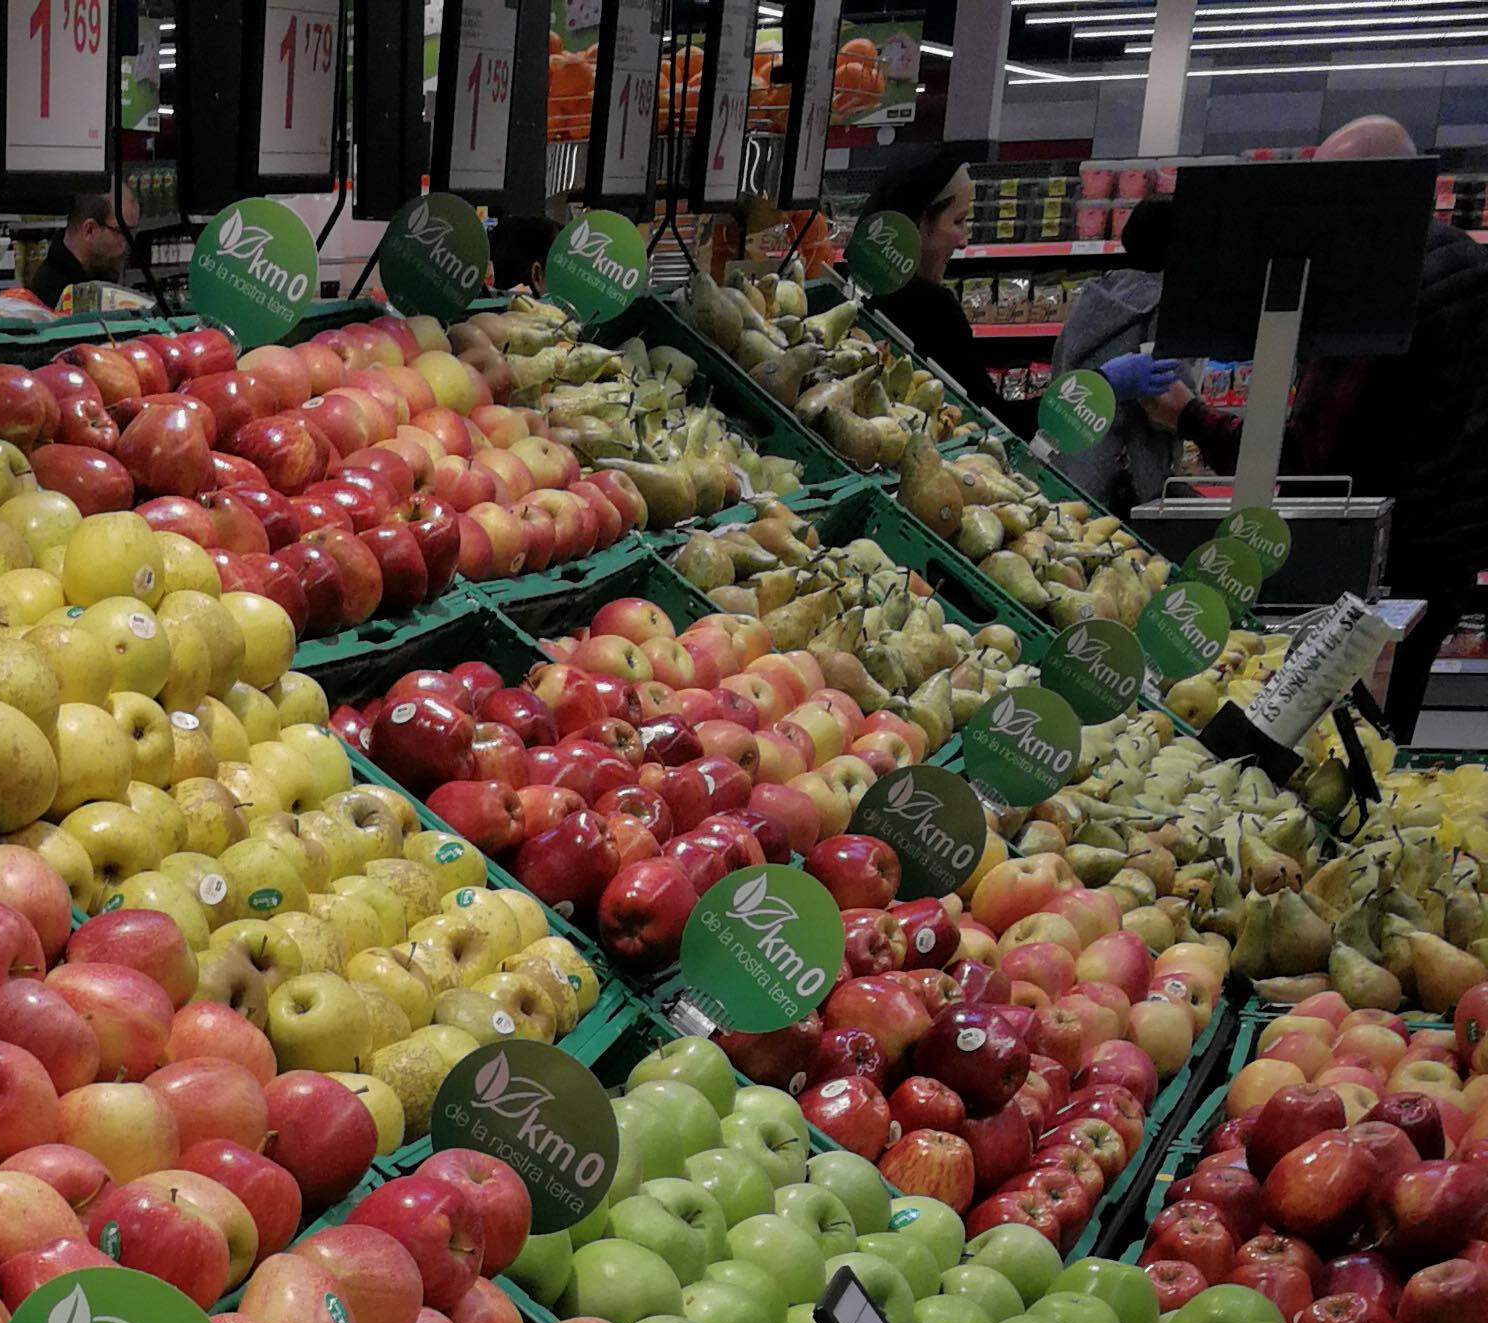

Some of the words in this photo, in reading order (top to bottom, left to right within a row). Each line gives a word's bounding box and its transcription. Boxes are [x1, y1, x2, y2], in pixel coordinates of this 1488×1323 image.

[700, 911, 721, 932] de
[718, 927, 734, 946] la
[730, 942, 771, 987] nostra
[768, 981, 799, 1018] terra
[444, 1103, 470, 1127] de
[471, 1119, 489, 1142] la
[488, 1136, 543, 1183] nostra
[545, 1175, 585, 1214] terra
